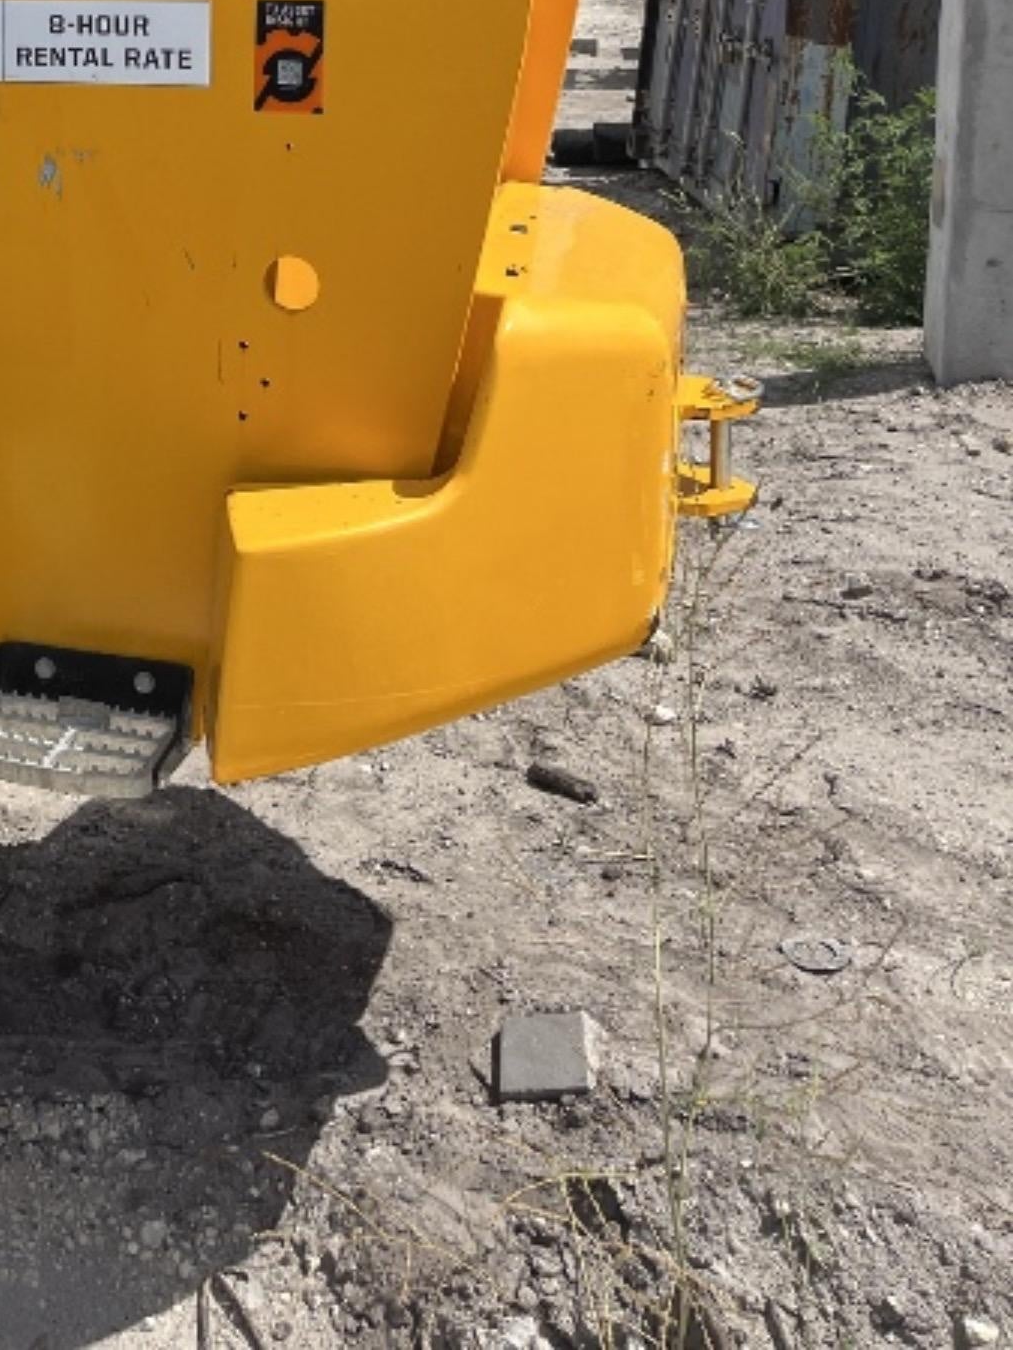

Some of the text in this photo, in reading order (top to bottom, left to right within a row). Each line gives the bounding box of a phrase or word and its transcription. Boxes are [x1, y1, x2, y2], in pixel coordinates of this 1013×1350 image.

[49, 14, 149, 37] 8-HOUR
[16, 47, 193, 69] RENTAL RATE
